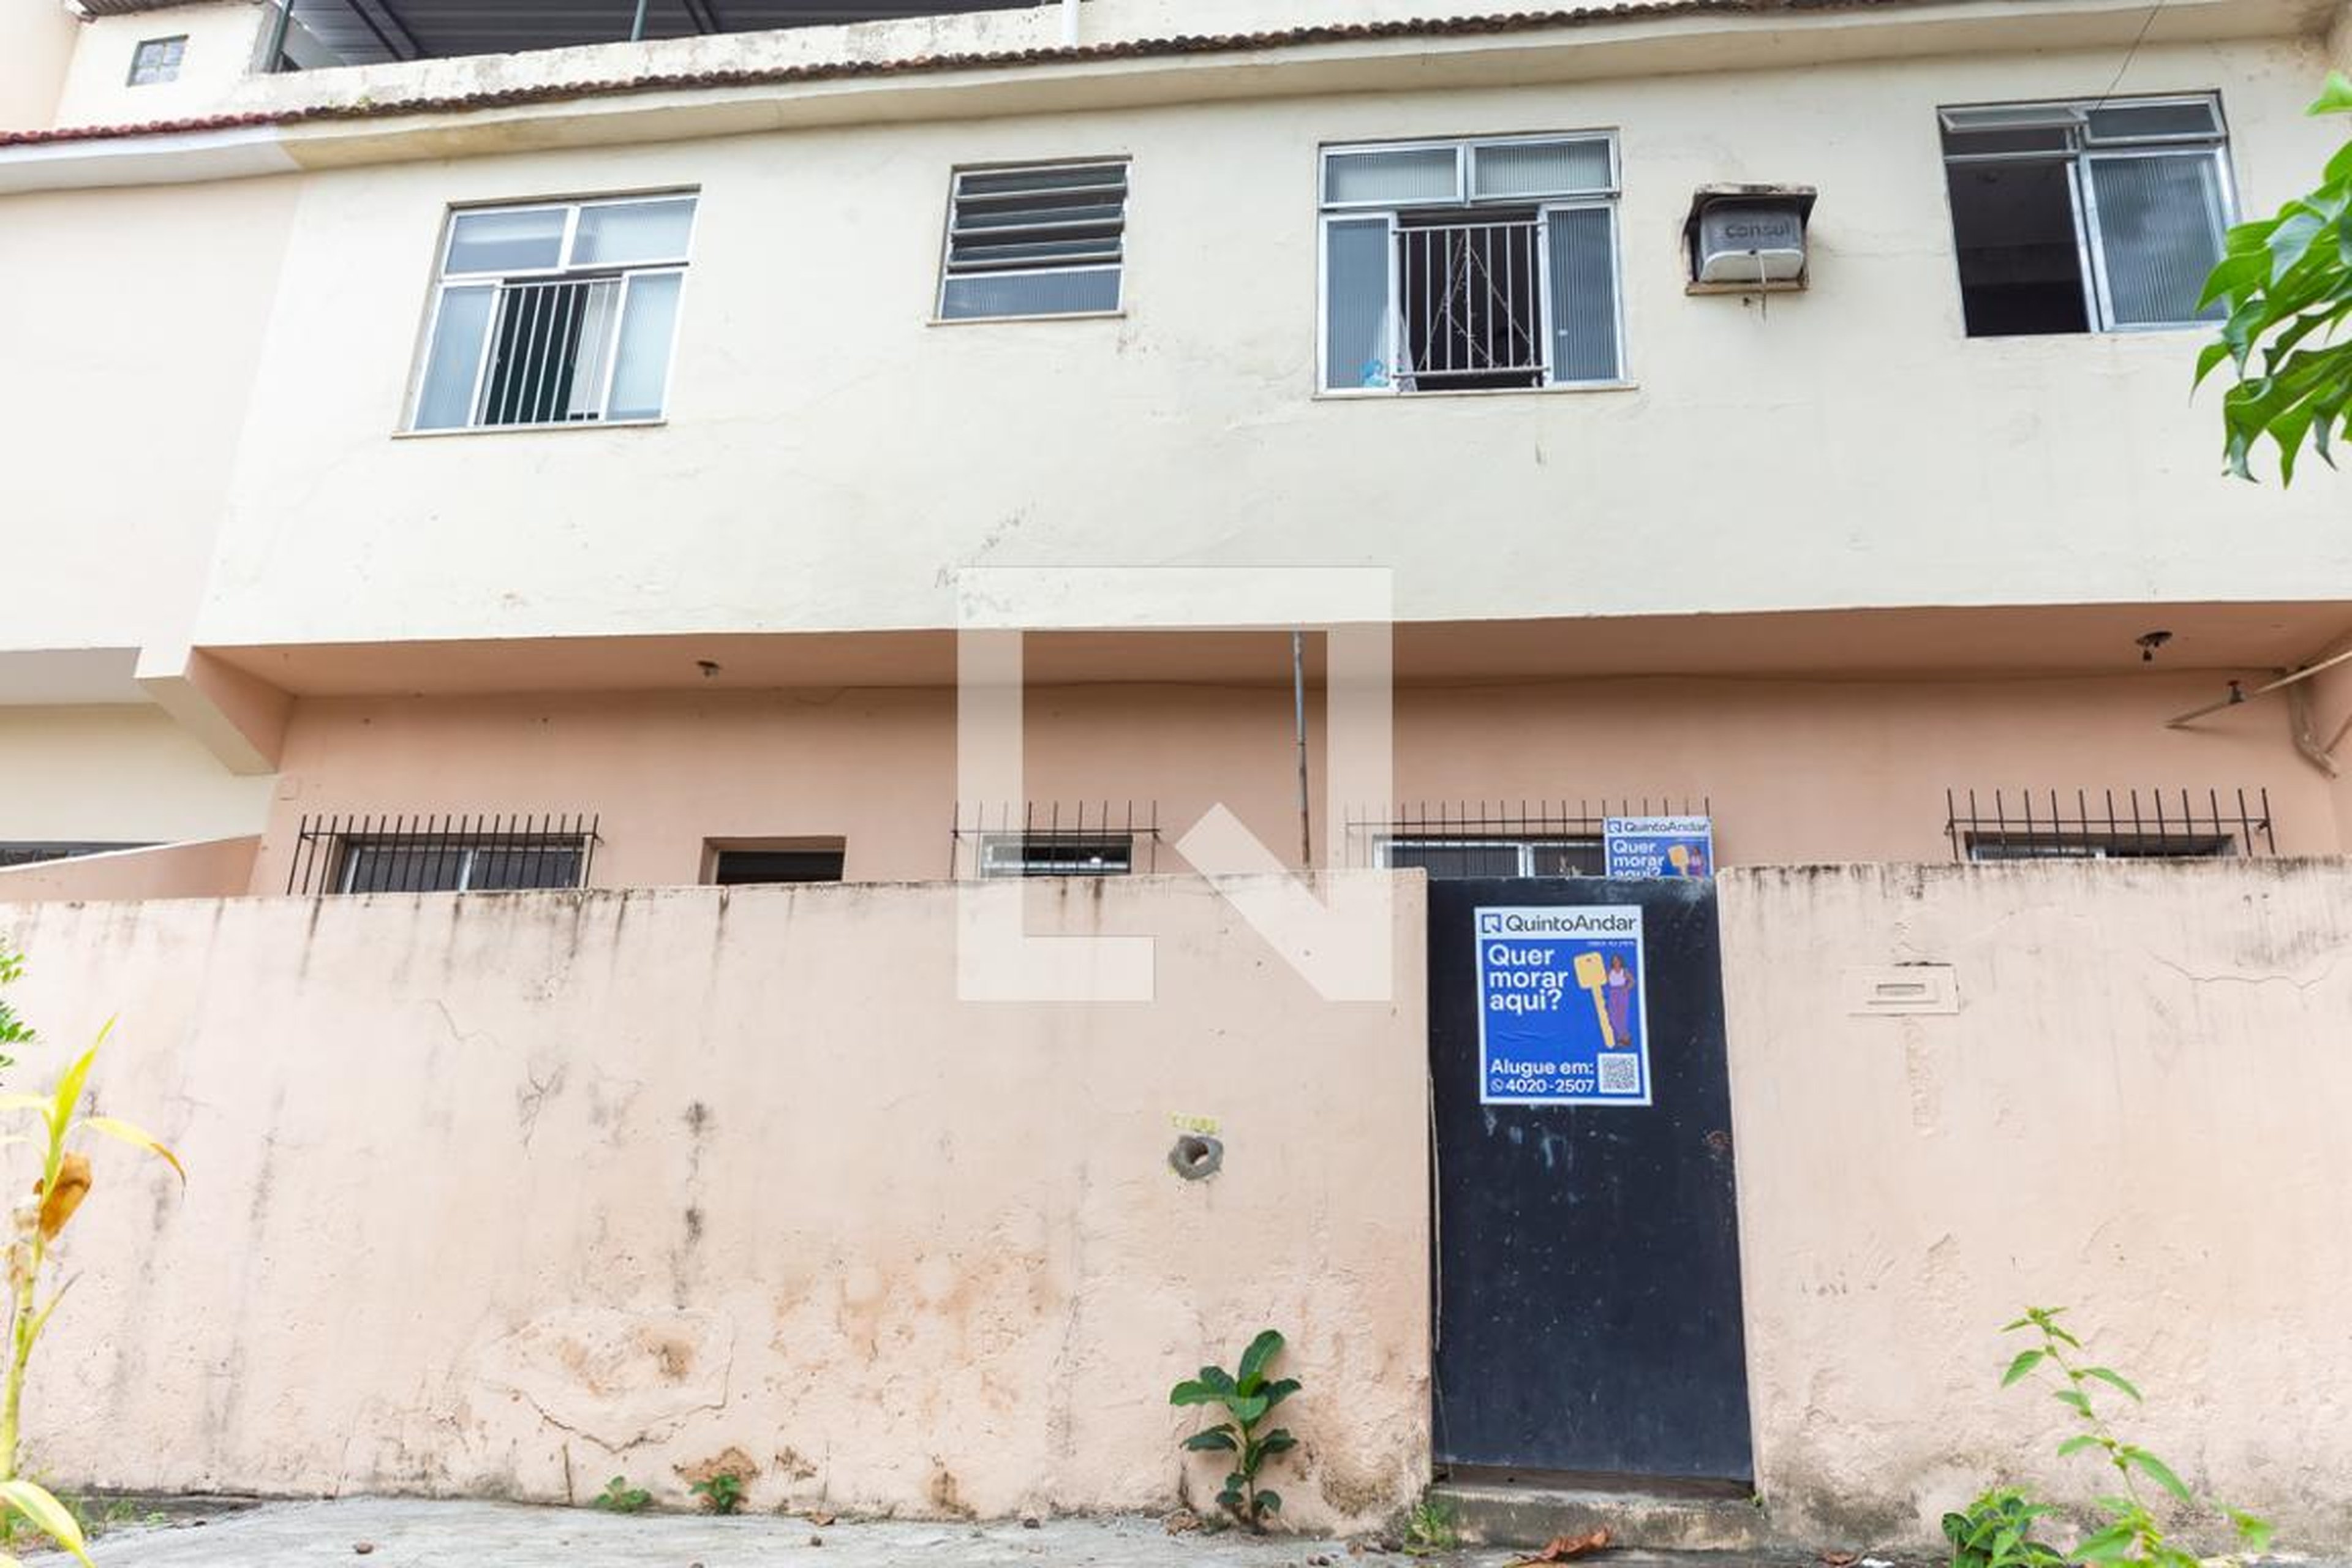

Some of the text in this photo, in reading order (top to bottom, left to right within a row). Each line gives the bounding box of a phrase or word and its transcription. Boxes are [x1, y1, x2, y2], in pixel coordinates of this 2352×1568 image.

[1725, 222, 1790, 239] consul
[1624, 821, 1708, 832] QuintoAndar
[1613, 840, 1657, 854] Quer
[1614, 856, 1664, 867] morar
[1506, 914, 1637, 932] QuintoAndar
[1488, 944, 1555, 966] Quer
[1490, 971, 1568, 989] morar
[1490, 989, 1562, 1015] aqui?
[1490, 1060, 1594, 1077] Alugue em:
[1506, 1079, 1595, 1093] 4020-2507
